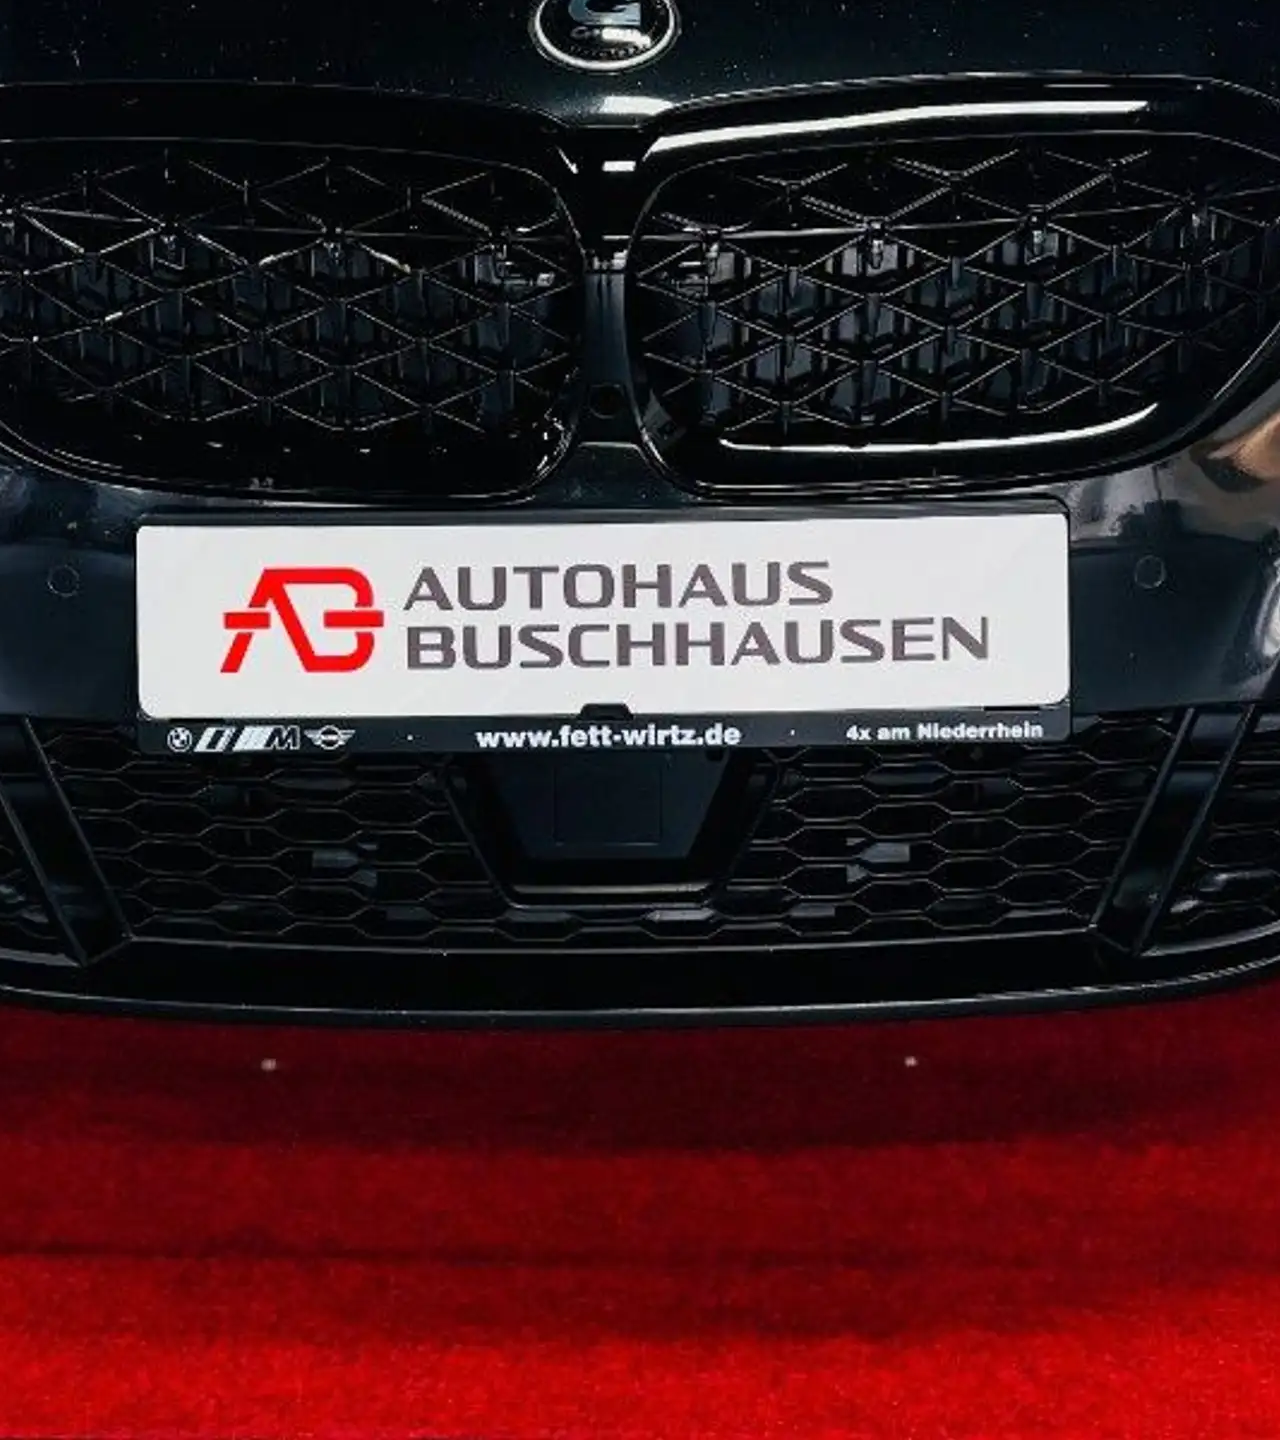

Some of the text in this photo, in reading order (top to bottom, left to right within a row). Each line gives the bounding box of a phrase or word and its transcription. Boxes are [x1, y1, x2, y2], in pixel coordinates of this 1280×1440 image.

[402, 560, 833, 612] AUTOHAUS
[405, 615, 990, 671] BUSCHHAUSEN
[475, 723, 741, 749] www.fett-wirtz.de
[846, 721, 1044, 741] 4x am Niederrhein
